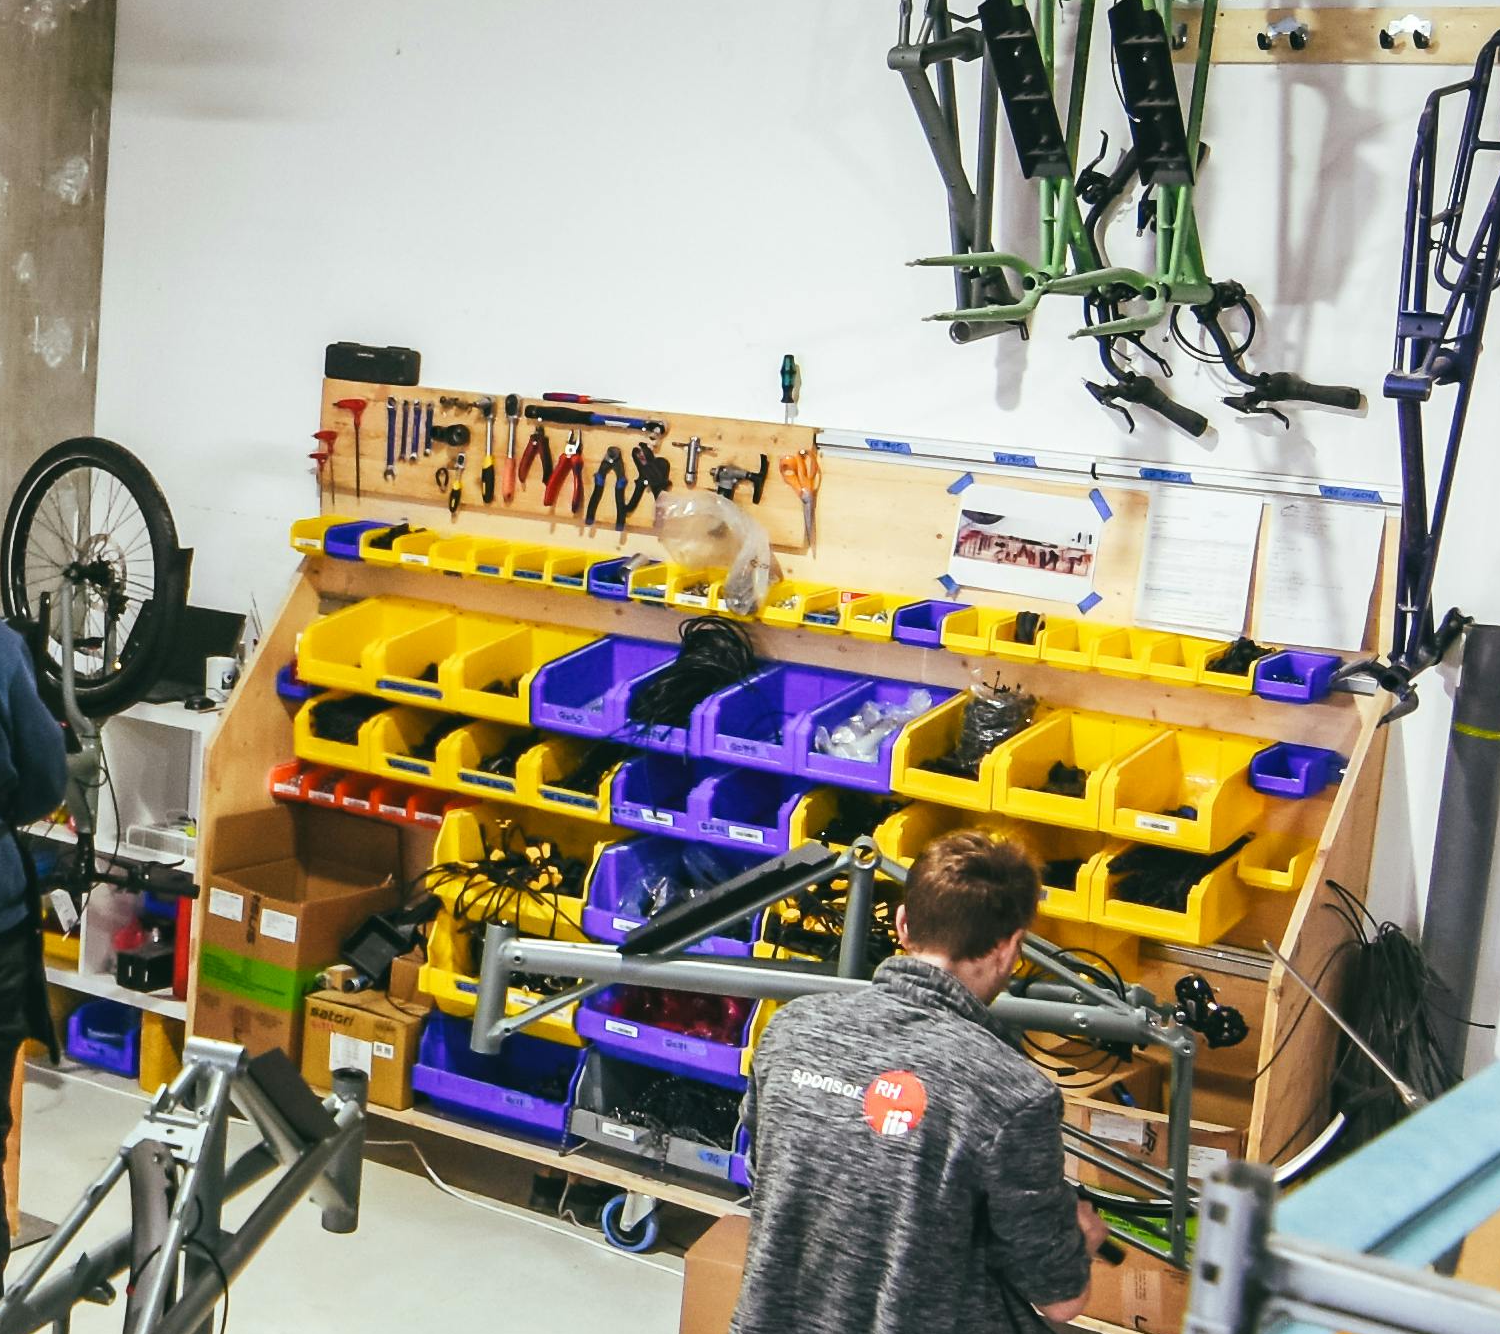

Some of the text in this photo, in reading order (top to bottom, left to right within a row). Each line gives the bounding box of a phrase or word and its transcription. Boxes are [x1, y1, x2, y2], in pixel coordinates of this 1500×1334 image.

[309, 1005, 355, 1027] satori
[791, 1069, 902, 1100] sponsor RH
